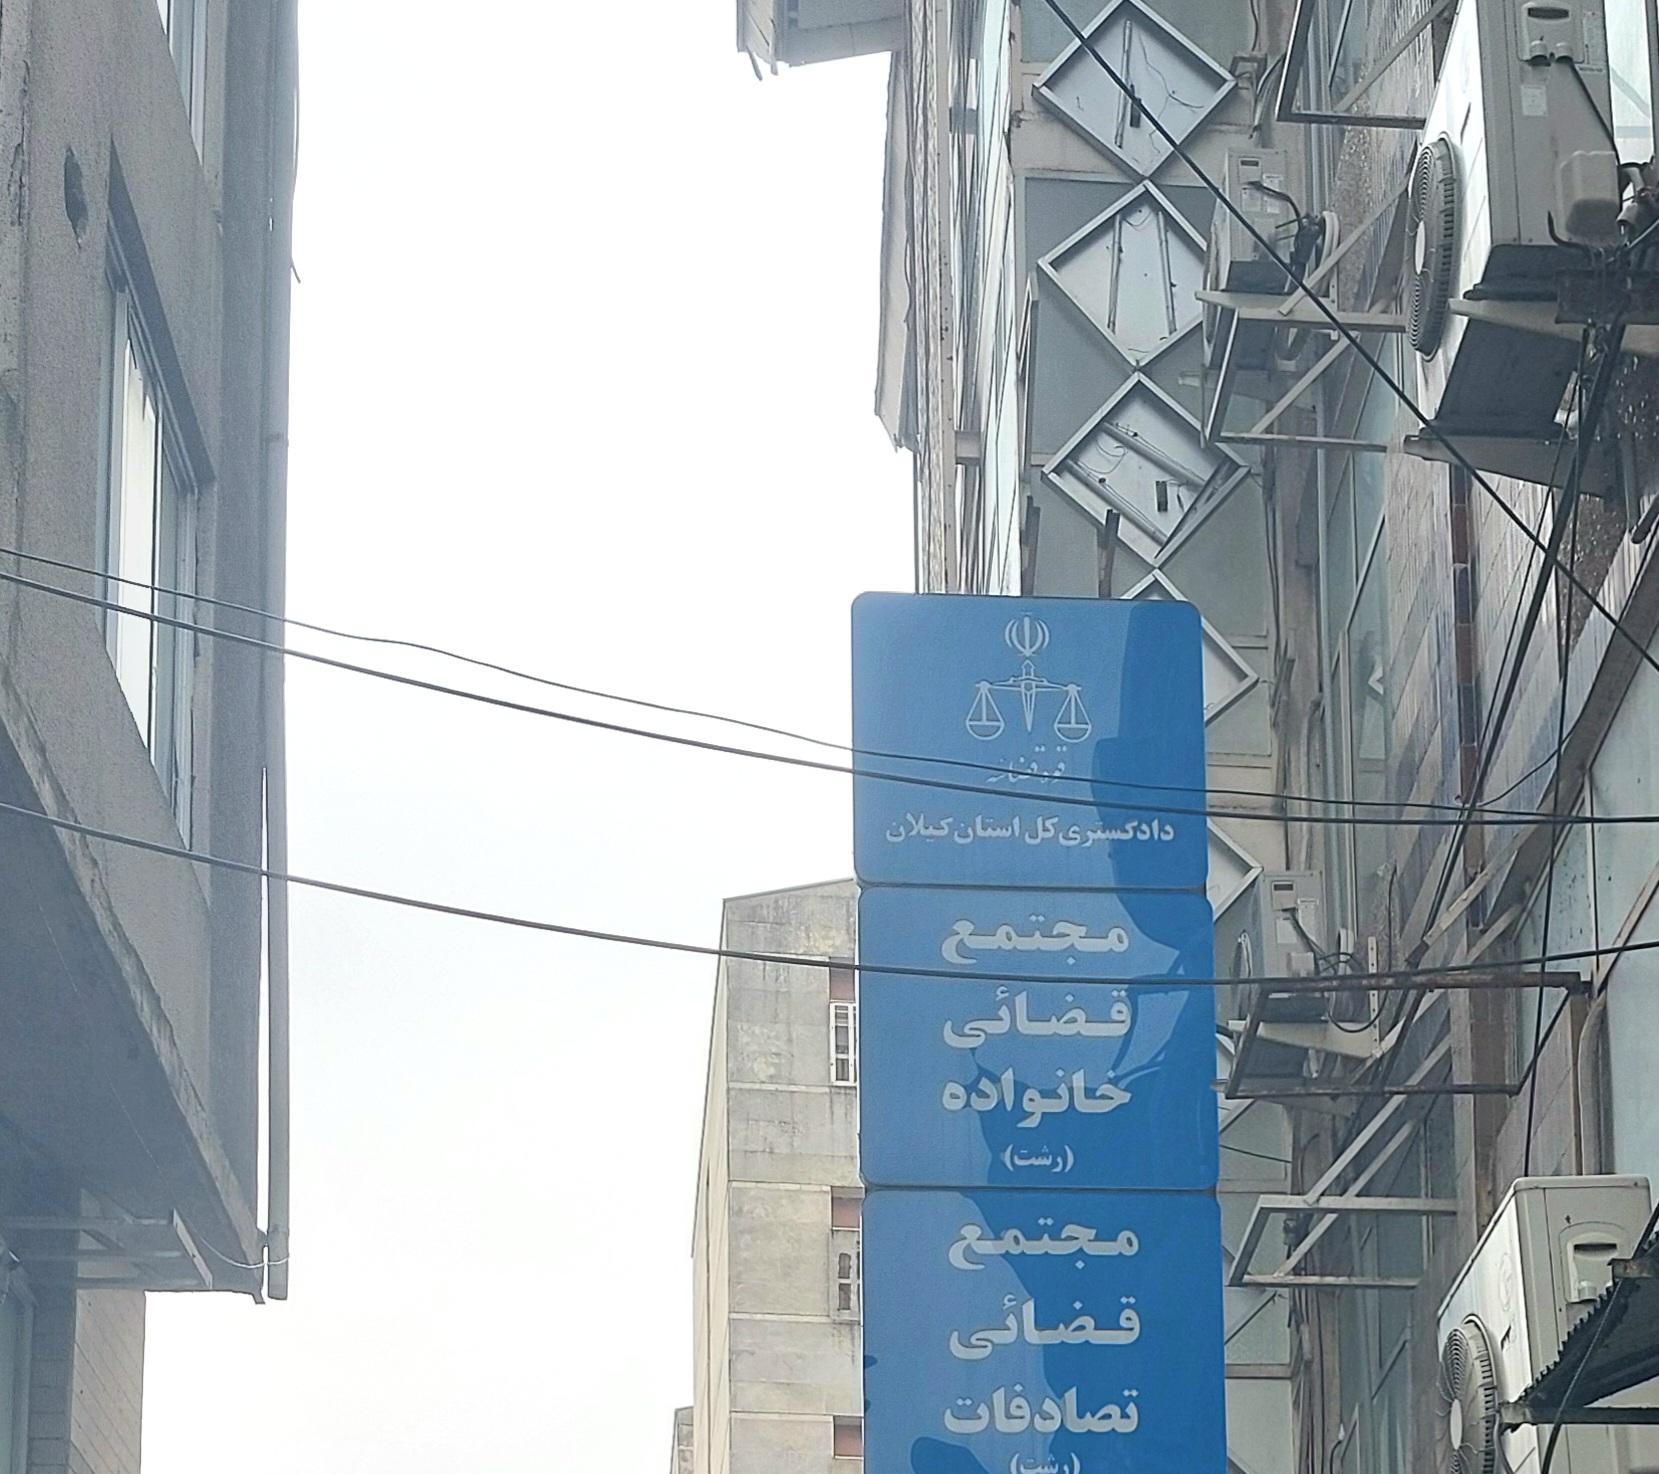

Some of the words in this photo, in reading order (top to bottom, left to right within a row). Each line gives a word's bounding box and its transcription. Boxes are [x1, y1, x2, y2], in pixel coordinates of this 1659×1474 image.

[954, 813, 1020, 844] استان
[1025, 815, 1059, 845] کل
[942, 913, 1130, 965] مجتمع
[943, 985, 1132, 1049] قضائی
[942, 1066, 1132, 1128] خانواده
[1003, 1144, 1074, 1173] (رشت)
[948, 1216, 1140, 1271] مجتمع
[949, 1293, 1141, 1361] قضائی
[943, 1383, 1140, 1434] تصادفات
